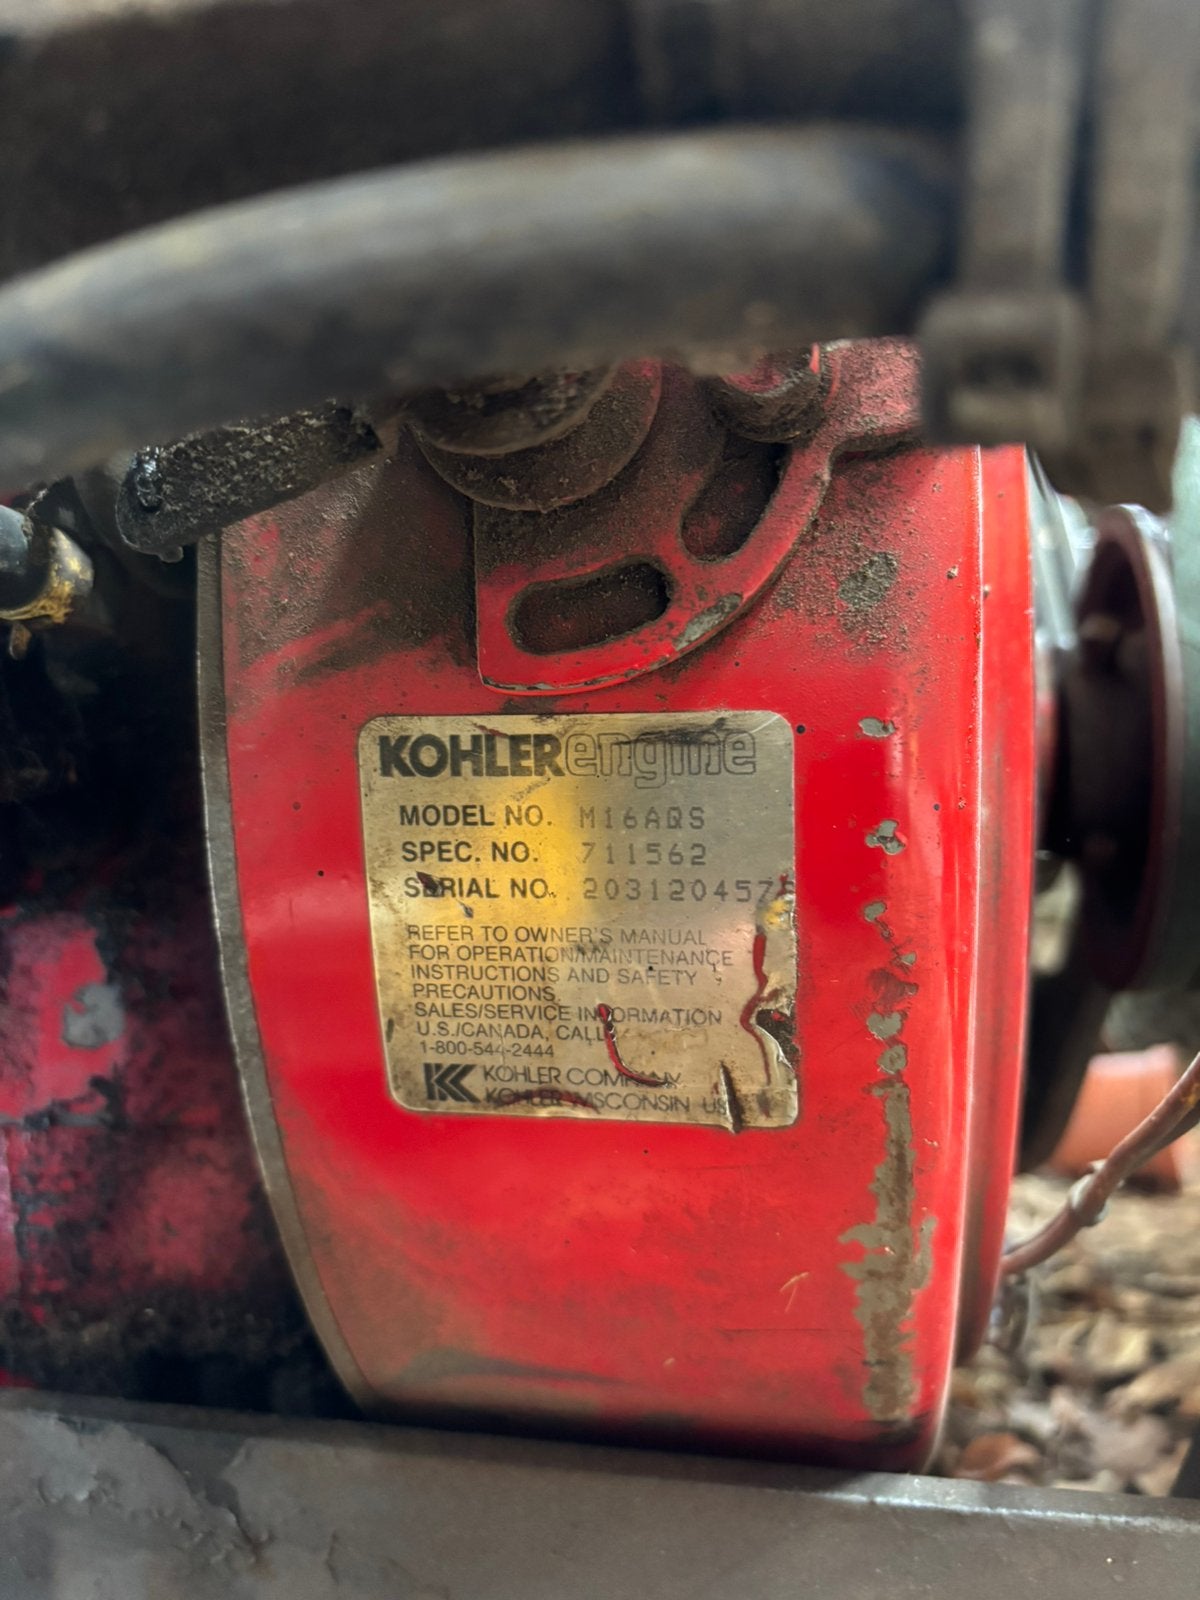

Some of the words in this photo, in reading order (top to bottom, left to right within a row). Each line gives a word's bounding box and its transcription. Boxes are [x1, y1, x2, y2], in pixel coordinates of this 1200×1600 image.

[379, 733, 565, 778] KOHLER
[400, 804, 495, 826] MODEL
[505, 805, 553, 827] NO.
[579, 806, 705, 830] M16AQS
[402, 841, 481, 863] SPEC.
[491, 841, 539, 862] NO.
[582, 842, 707, 866] 711562
[510, 878, 557, 899] NO.
[408, 924, 474, 942] REFER
[480, 925, 508, 942] TO
[514, 925, 613, 944] OWNER'S
[620, 928, 707, 946] MANUAL
[409, 944, 450, 961] FOR
[411, 964, 560, 983] INSTRUCTIONS
[567, 967, 610, 984] AND
[617, 969, 698, 986] SAFETY
[413, 983, 561, 1002] PRECAUTIONS.
[414, 1001, 572, 1022] SALES/SERVICE
[578, 1005, 722, 1026] INORMATION
[417, 1020, 549, 1042] U.S./CANADA,
[555, 1024, 605, 1042] CALL
[484, 1064, 562, 1085] KOHLER
